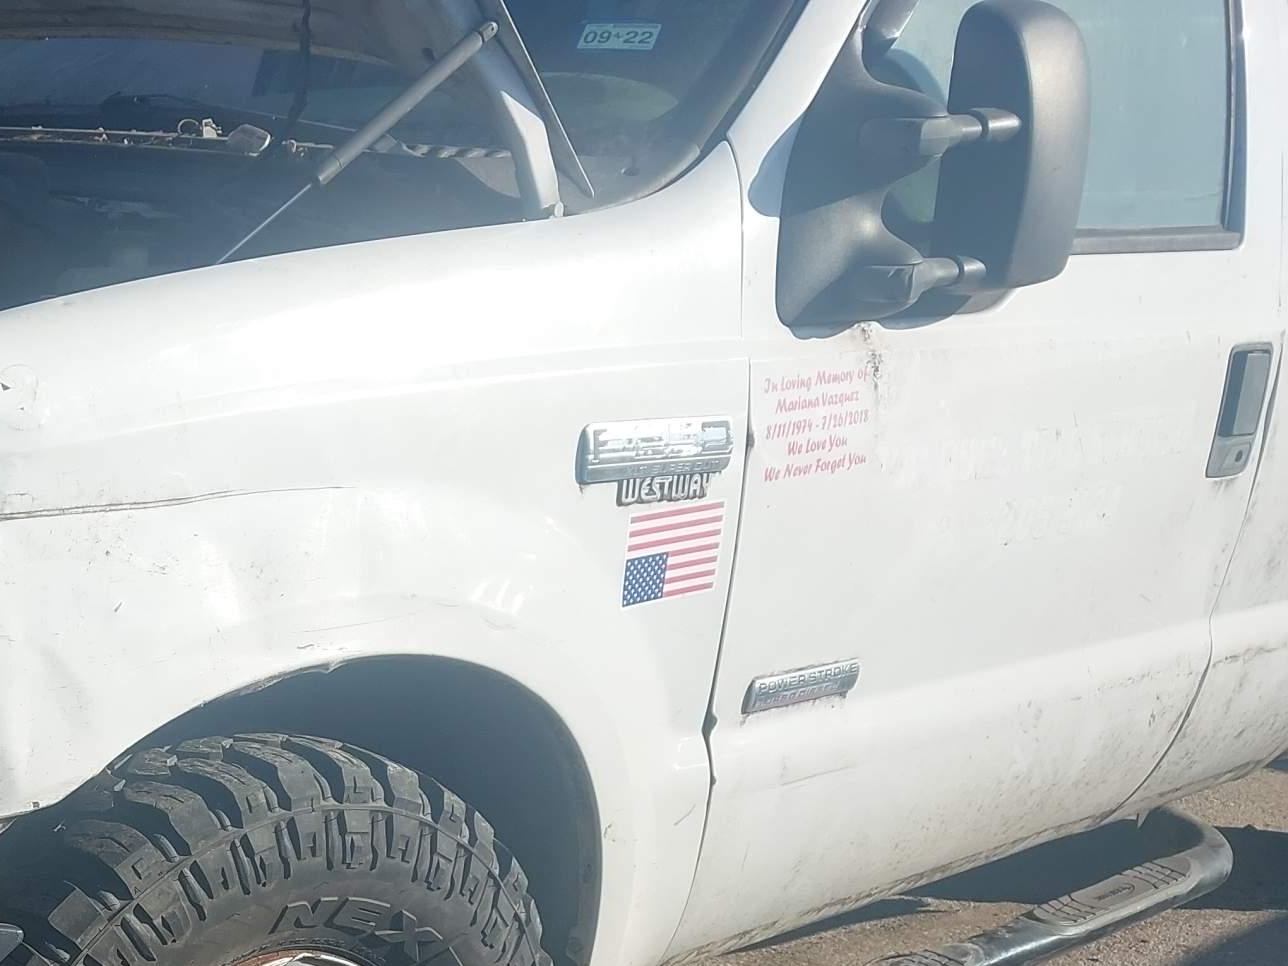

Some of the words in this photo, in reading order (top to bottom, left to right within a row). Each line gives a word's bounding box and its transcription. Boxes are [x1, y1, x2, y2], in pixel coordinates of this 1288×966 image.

[764, 377, 778, 393] In
[780, 374, 812, 393] Loving
[815, 370, 855, 386] Memory
[857, 365, 870, 382] of
[775, 395, 819, 414] Mariana
[766, 418, 813, 440] 8/11/1974
[787, 441, 803, 456] We
[805, 438, 827, 454] Love
[827, 434, 848, 452] You
[764, 466, 781, 482] We
[783, 463, 813, 479] Never
[815, 453, 847, 473] Forget
[847, 451, 867, 470] You
[619, 472, 713, 506] WESTWAY
